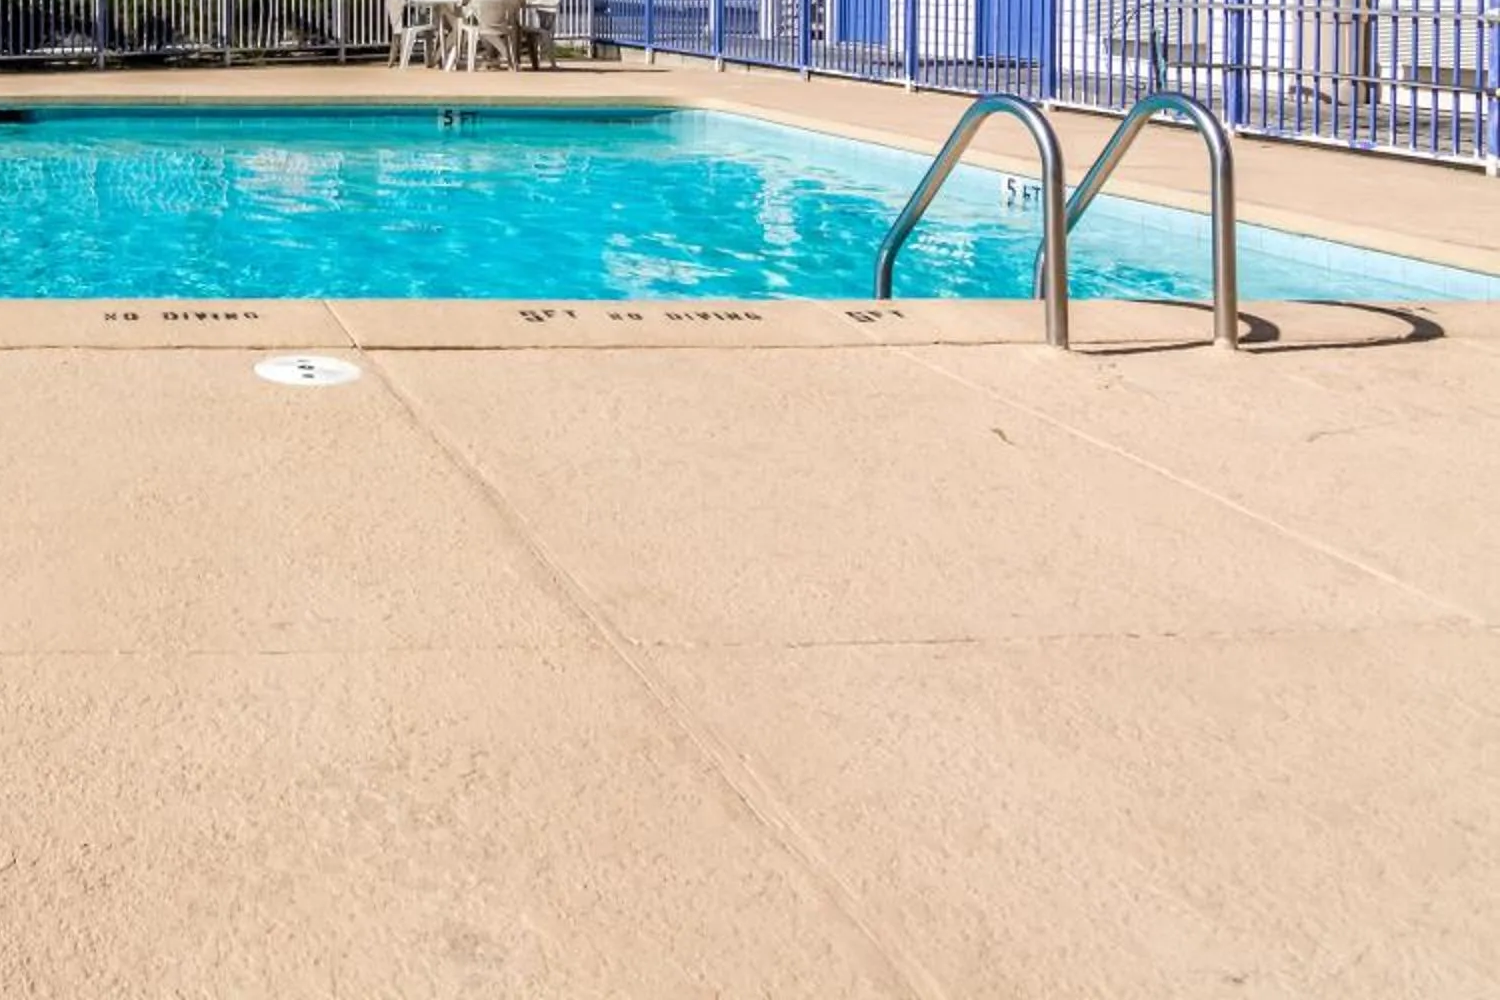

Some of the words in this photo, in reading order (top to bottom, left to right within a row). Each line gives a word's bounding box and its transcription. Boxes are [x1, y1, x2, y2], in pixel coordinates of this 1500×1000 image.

[104, 311, 139, 321] NO
[162, 311, 260, 321] DIVING
[609, 311, 643, 321] NO
[664, 311, 764, 322] DIVING
